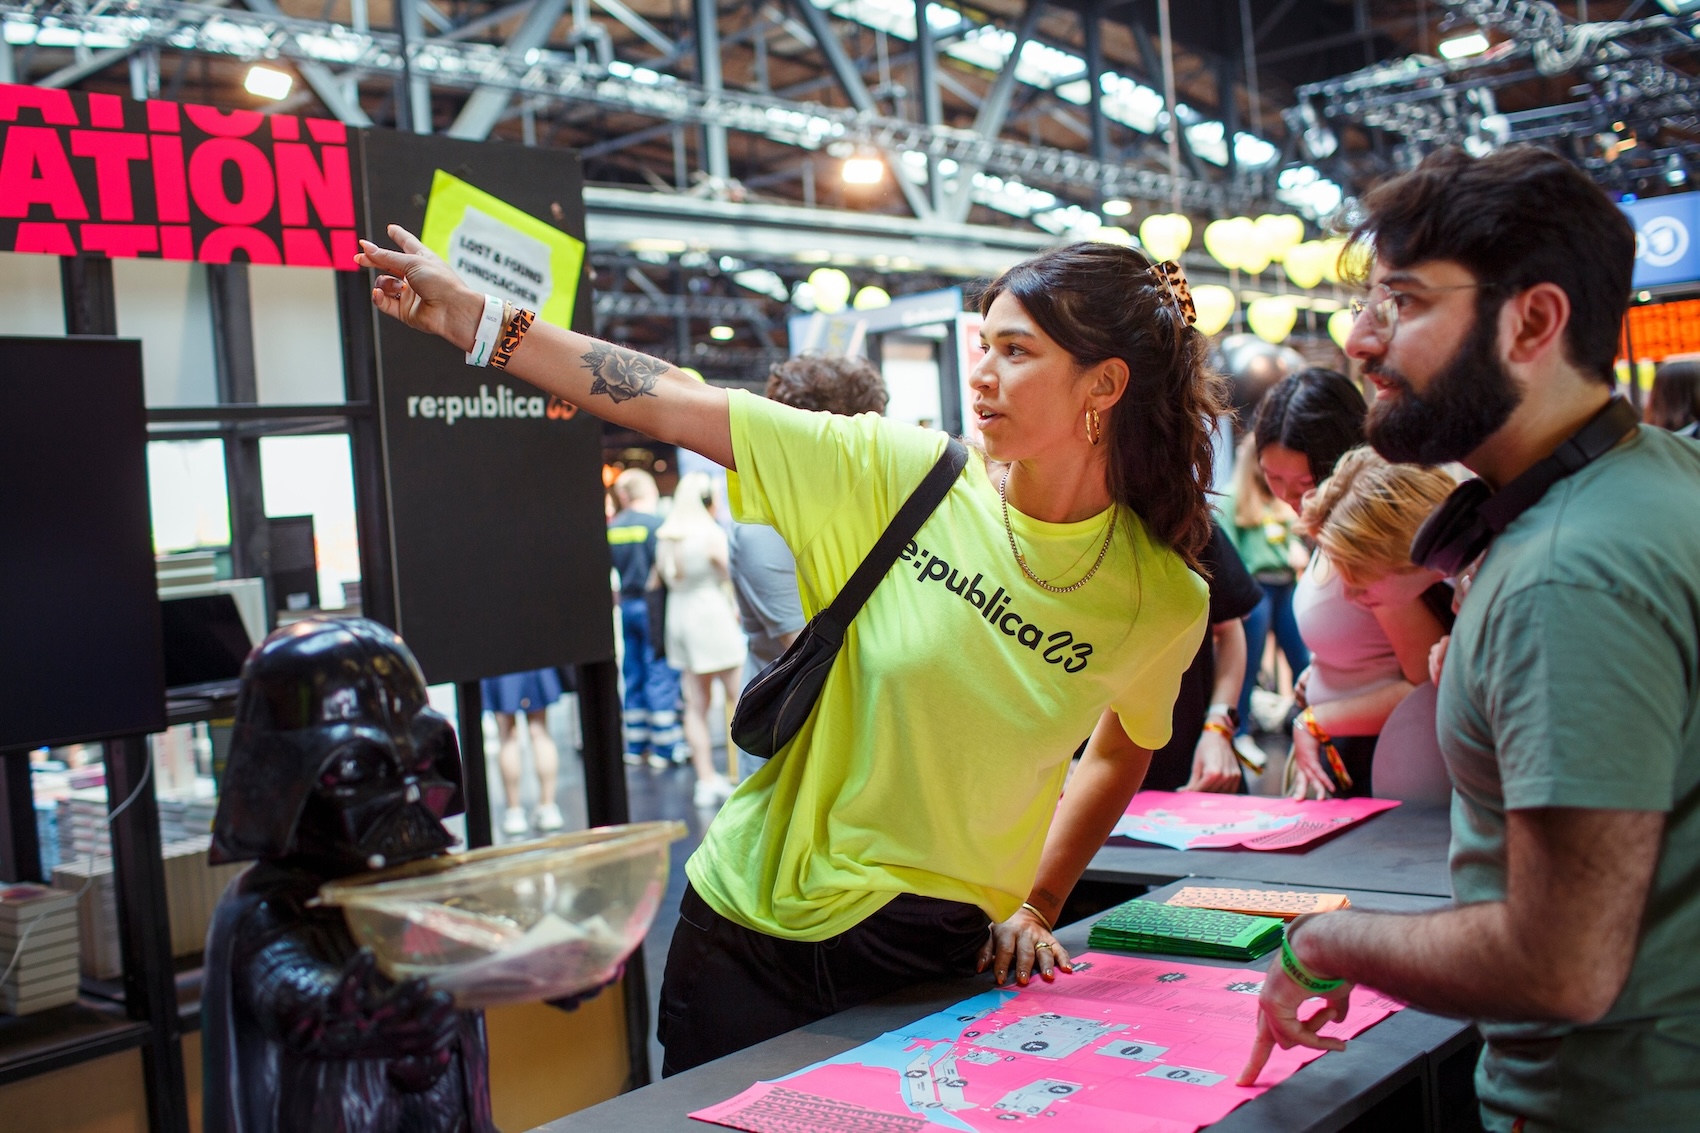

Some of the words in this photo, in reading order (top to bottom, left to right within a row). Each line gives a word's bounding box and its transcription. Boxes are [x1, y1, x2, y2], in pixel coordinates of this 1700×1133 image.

[0, 125, 355, 228] ATION
[459, 236, 491, 259] LOST
[504, 256, 544, 284] FOUND
